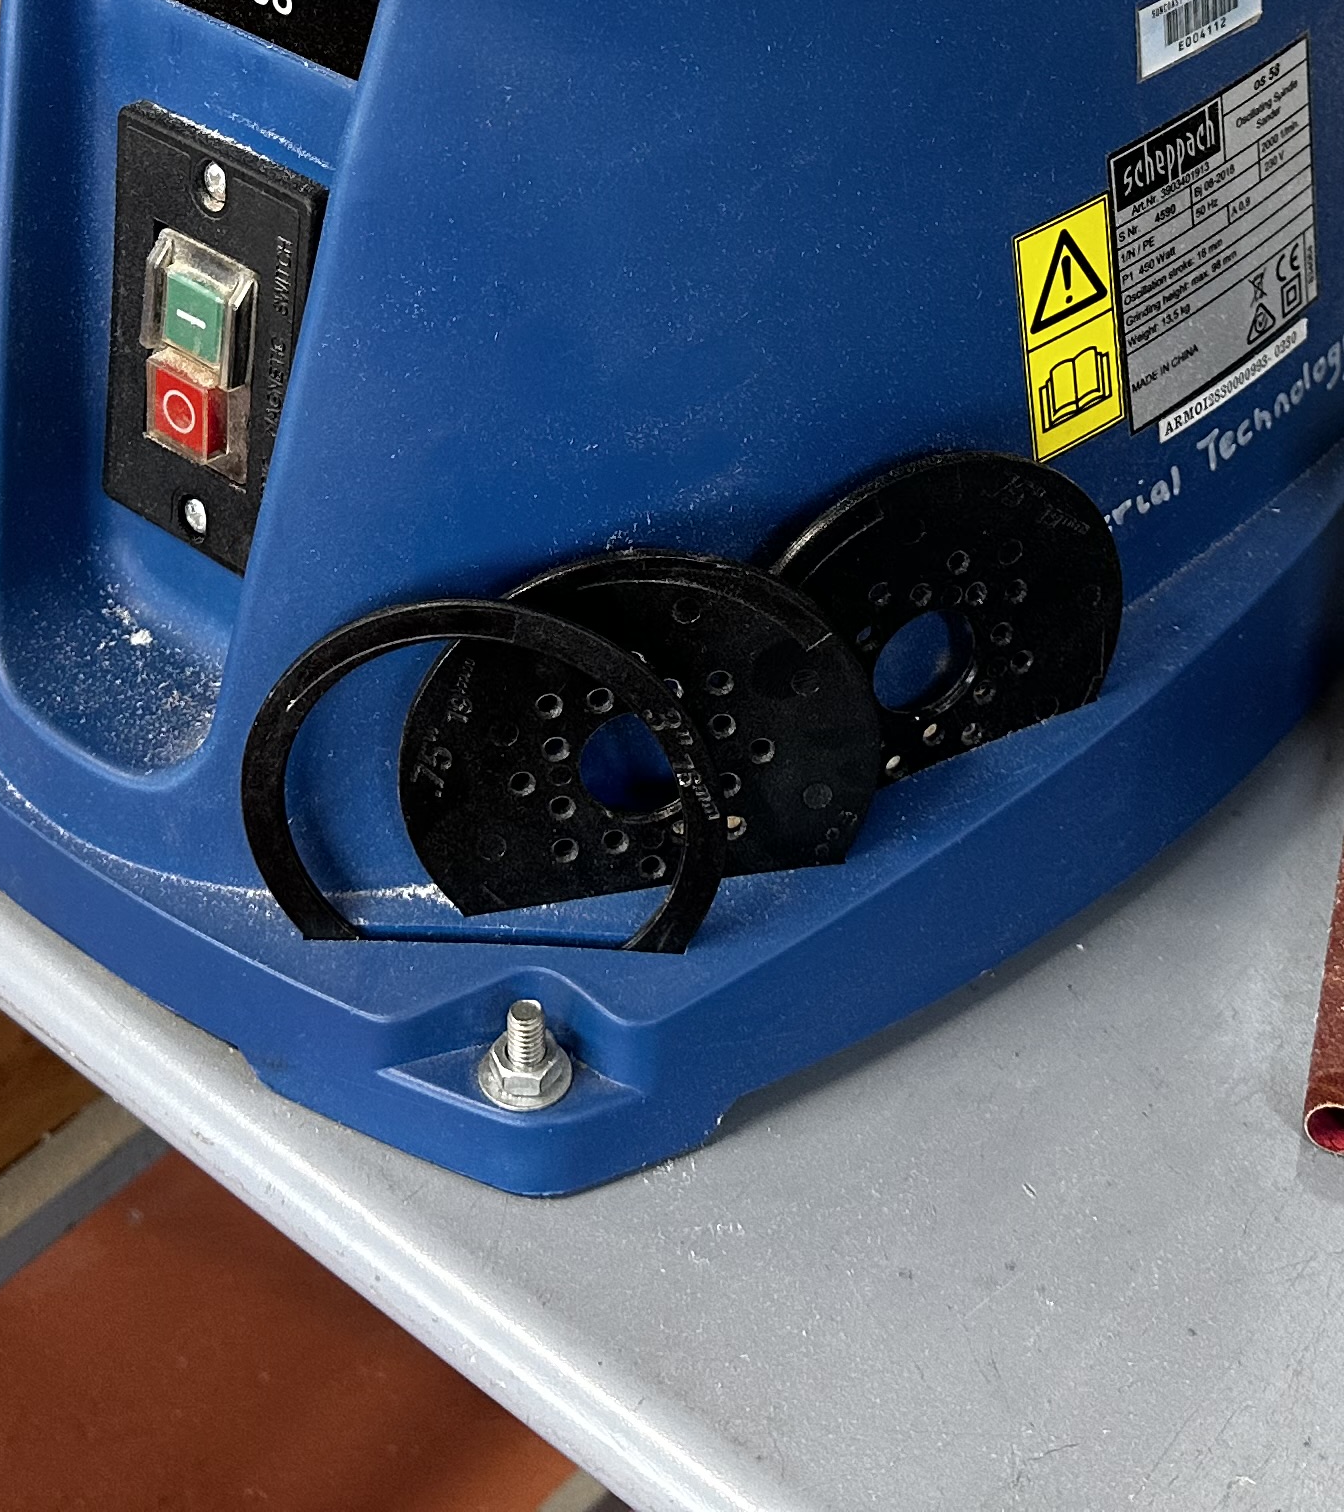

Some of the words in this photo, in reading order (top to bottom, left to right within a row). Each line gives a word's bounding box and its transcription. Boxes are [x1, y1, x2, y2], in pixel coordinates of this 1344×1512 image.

[1178, 16, 1227, 52] E004112
[1123, 105, 1216, 196] scheppach
[1196, 205, 1206, 218] 50
[1207, 199, 1218, 210] Hz
[1143, 236, 1155, 251] PE
[1122, 271, 1133, 285] P1
[1157, 247, 1175, 264] Watt
[1124, 276, 1166, 305] Oscillation
[1208, 239, 1222, 253] mm
[1126, 301, 1161, 326] Grinding
[1223, 251, 1236, 265] mm
[1180, 304, 1190, 315] kg
[1132, 371, 1157, 392] MADE
[1160, 362, 1169, 375] IN
[1171, 344, 1198, 367] CHINA
[1104, 465, 1181, 532] rial
